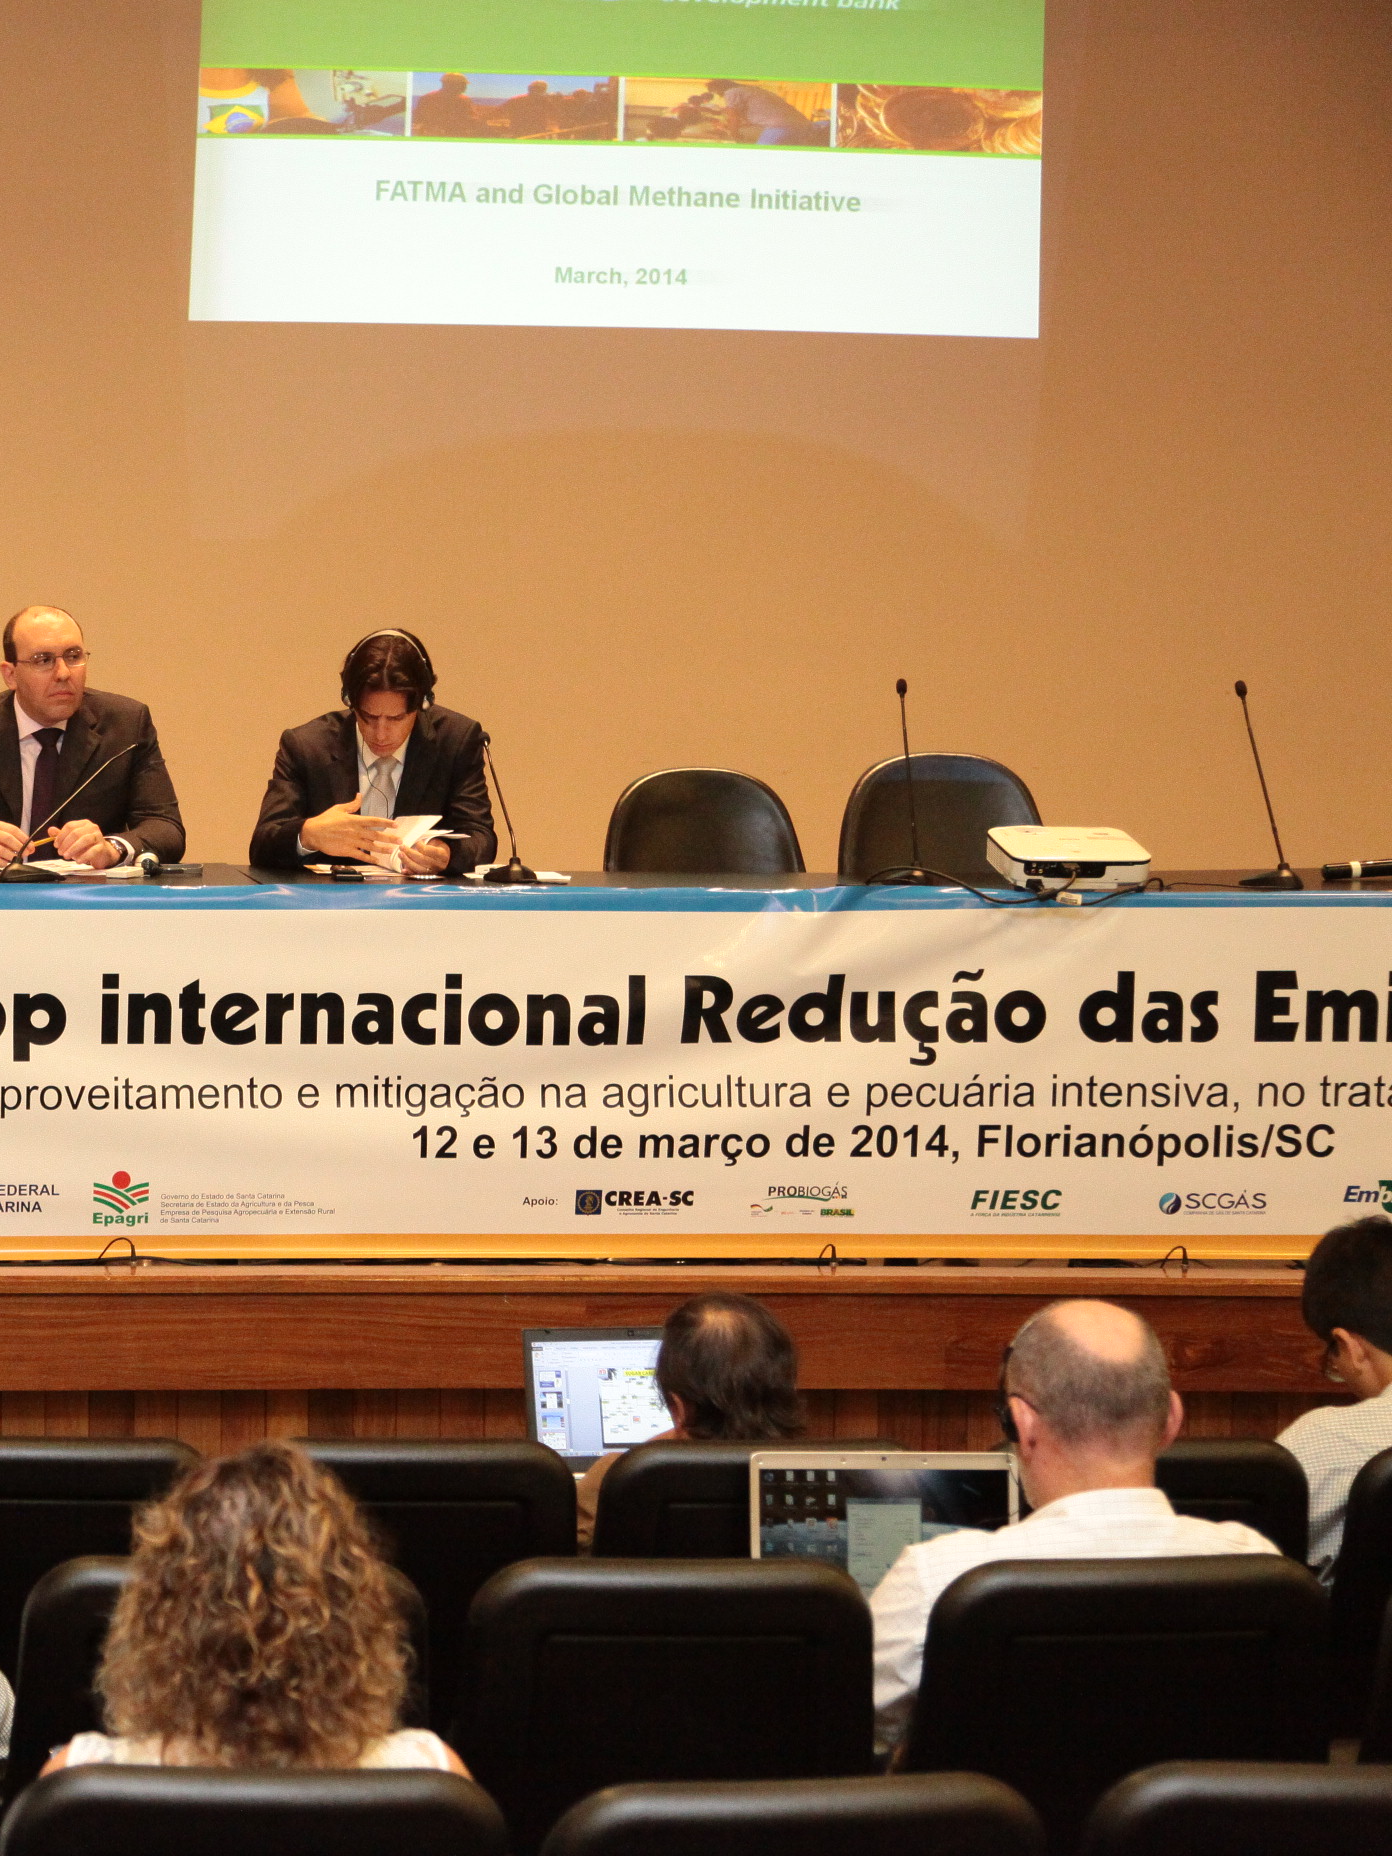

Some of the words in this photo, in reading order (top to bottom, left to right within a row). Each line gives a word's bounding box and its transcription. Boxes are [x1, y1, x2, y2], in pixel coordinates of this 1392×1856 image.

[376, 180, 467, 203] FATMA
[476, 183, 524, 204] and
[533, 184, 619, 206] Global
[629, 185, 741, 208] Methane
[751, 188, 861, 212] Initiative
[555, 266, 628, 287] March,
[635, 268, 688, 285] 2014
[101, 973, 645, 1046] internacional
[681, 969, 1046, 1066] Redução
[1079, 971, 1219, 1043] das
[298, 1084, 319, 1108] e
[336, 1075, 524, 1117] mitigação
[541, 1083, 586, 1108] na
[603, 1075, 811, 1117] agricultura
[828, 1083, 849, 1108] e
[866, 1074, 1034, 1116] pecuária
[1052, 1074, 1239, 1112] intensiva,
[1258, 1082, 1305, 1107] no
[1320, 1076, 1392, 1107] trat
[413, 1126, 457, 1158] 12
[473, 1134, 495, 1159] e
[513, 1126, 557, 1159] 13
[574, 1126, 622, 1159] de
[638, 1130, 770, 1166] março
[786, 1125, 835, 1157] de
[850, 1125, 959, 1164] 2014,
[978, 1124, 1335, 1166] Florianópolis/SC
[605, 1190, 694, 1207] CREA-SC
[768, 1181, 848, 1197] PROBIOGÁS
[523, 1197, 558, 1208] Apoio:
[970, 1189, 1063, 1210] FIESC
[1185, 1190, 1267, 1209] SCGÁS
[93, 1213, 148, 1227] Epagri
[820, 1208, 855, 1216] BRASIL
